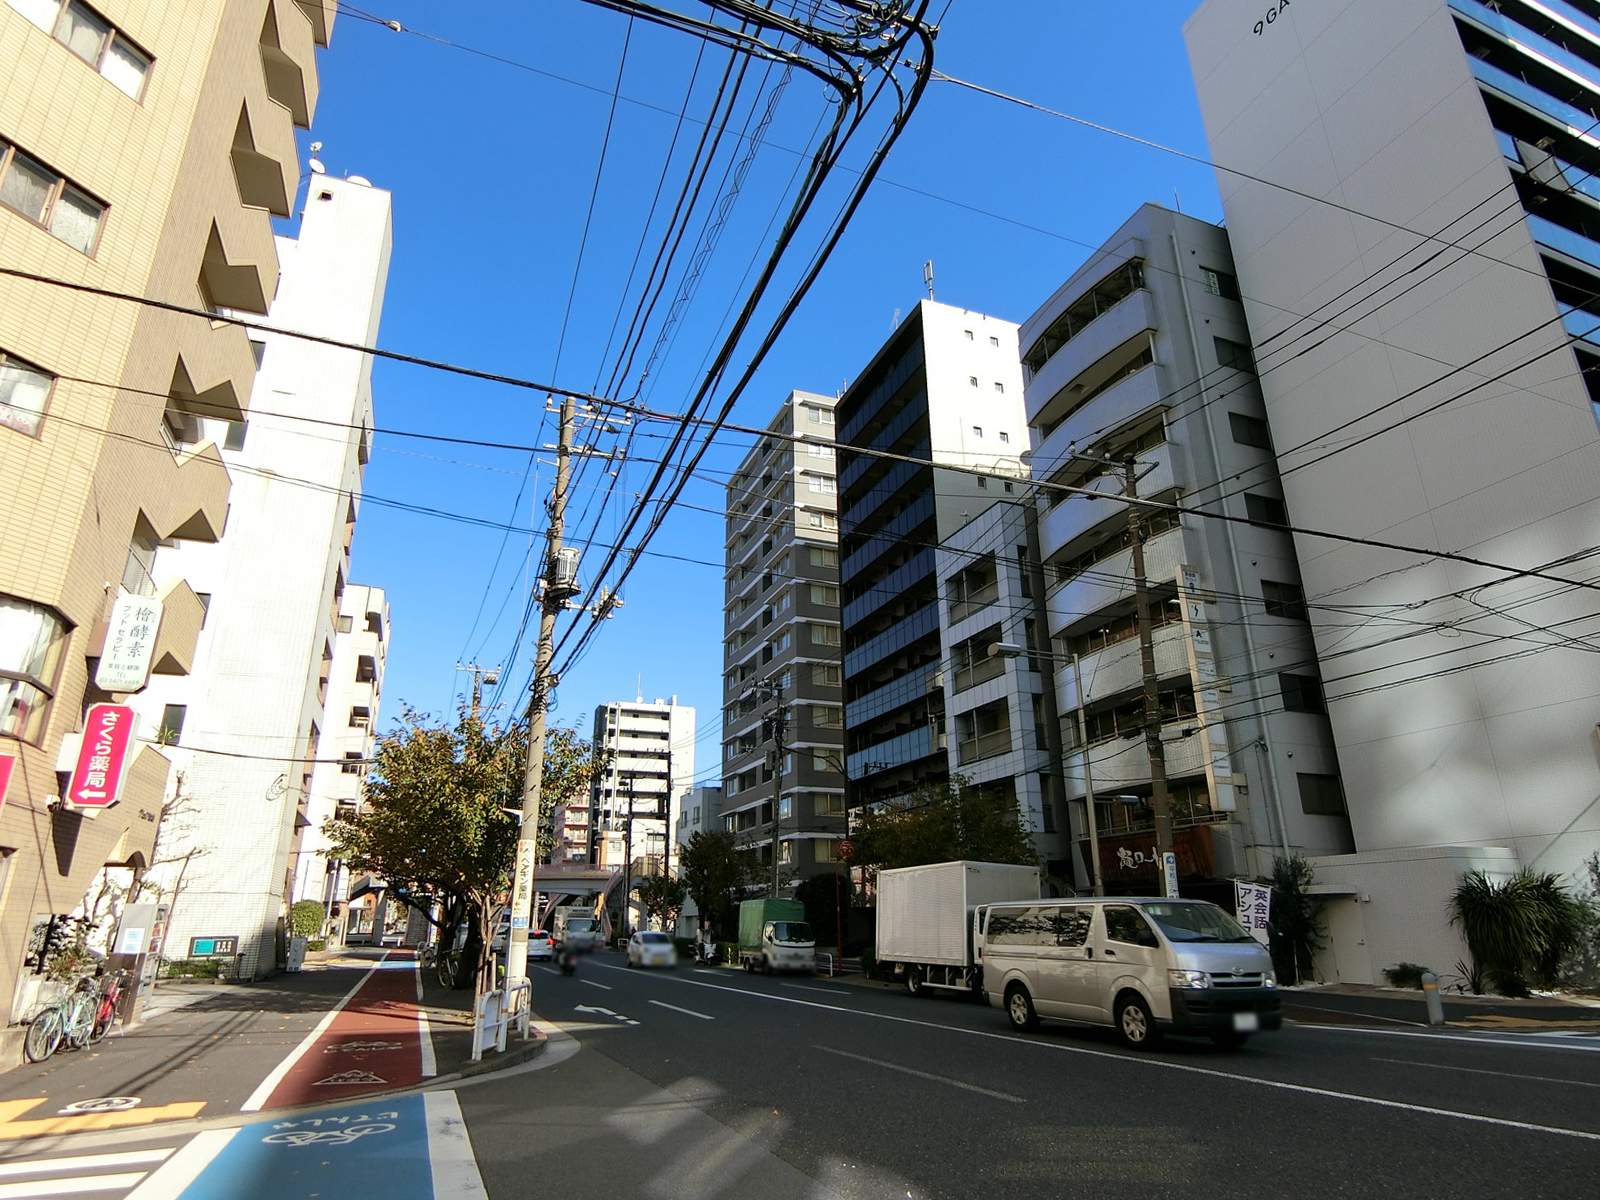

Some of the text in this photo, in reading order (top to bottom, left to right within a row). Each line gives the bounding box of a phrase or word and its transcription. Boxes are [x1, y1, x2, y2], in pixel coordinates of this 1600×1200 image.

[83, 711, 121, 788] さくら薬局
[1254, 889, 1268, 929] 英会話
